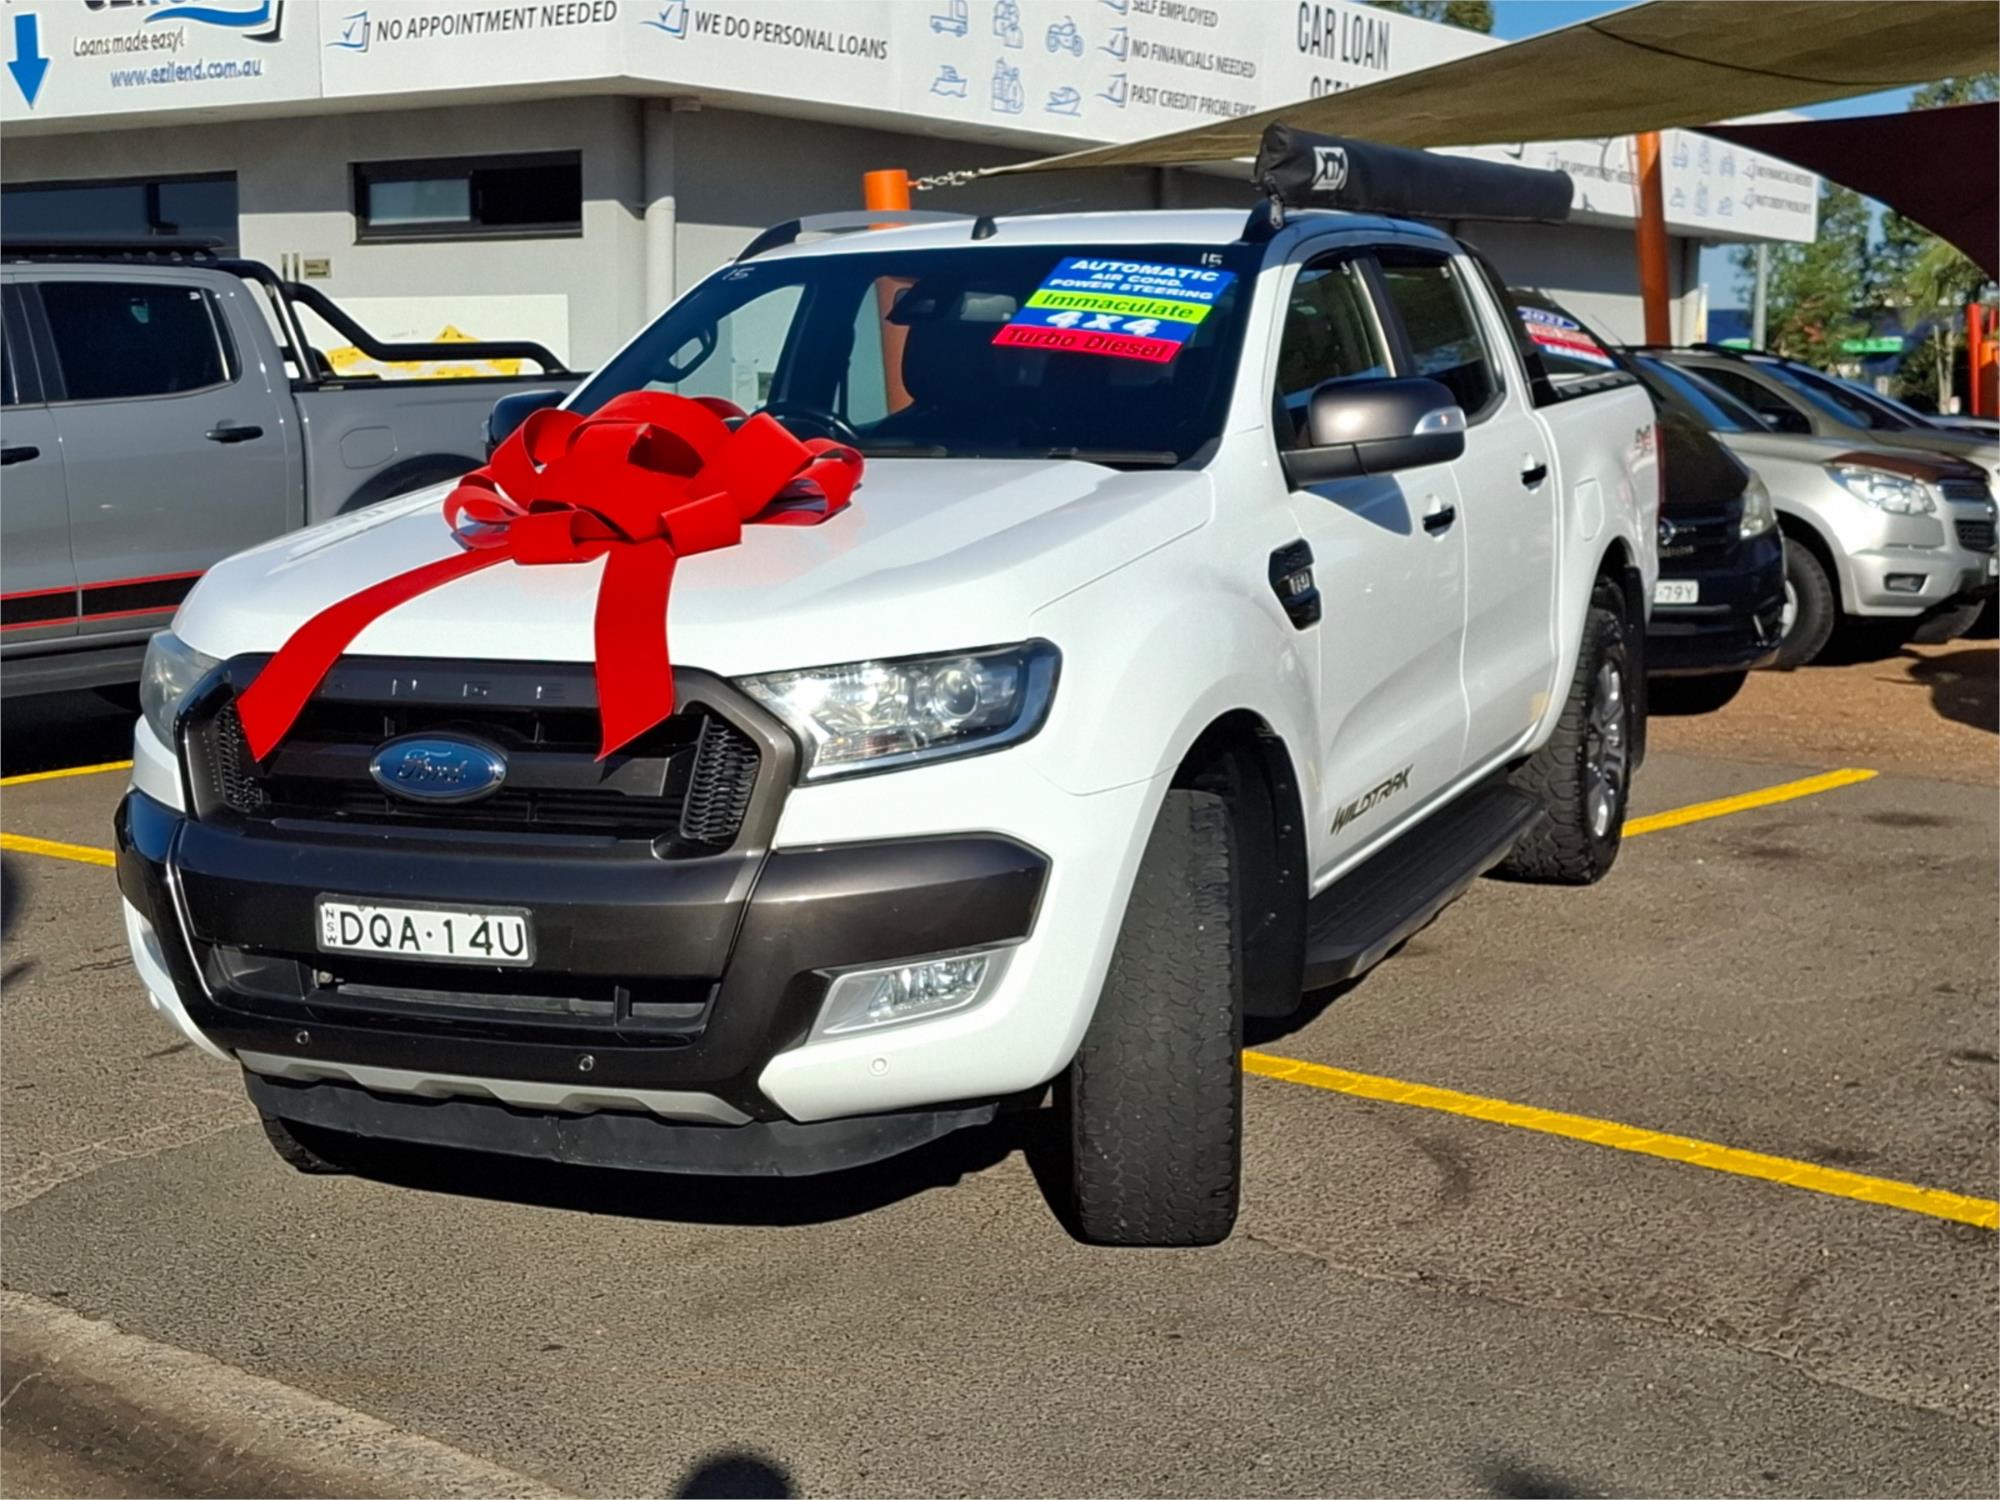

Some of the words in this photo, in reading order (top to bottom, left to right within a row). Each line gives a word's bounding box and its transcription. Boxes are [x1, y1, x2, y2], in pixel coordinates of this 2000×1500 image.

[376, 20, 402, 42] NO
[407, 7, 537, 39] APPOINTMENT
[541, 0, 618, 28] NEEDED
[1159, 0, 1219, 27] EMPLOYED
[73, 35, 110, 57] Loans
[112, 29, 149, 53] made
[151, 26, 185, 54] easy!
[695, 10, 721, 35] WE
[724, 16, 750, 39] DO
[753, 20, 834, 52] PERSONAL
[838, 33, 888, 60] LOANS
[1298, 1, 1336, 60] CAR
[1341, 12, 1390, 71] LOAN
[110, 58, 263, 88] www.ezilend.com.au
[1131, 39, 1149, 59] NO
[1150, 43, 1213, 71] FINANCIALS
[1215, 56, 1257, 79] NEEDED
[1130, 84, 1158, 106] PAST
[1159, 90, 1198, 112] CREDIT
[1070, 259, 1220, 282] AUTOMATIC
[1091, 272, 1124, 282] AIR
[1127, 275, 1184, 288] COND.
[1049, 278, 1116, 292] POWER
[1119, 283, 1215, 301] STEERING
[1042, 293, 1194, 320] Immaculate
[1007, 328, 1079, 346] Turbo
[1084, 336, 1169, 359] Diesel
[396, 748, 469, 784] Ford
[1330, 762, 1414, 836] WILDTRAK
